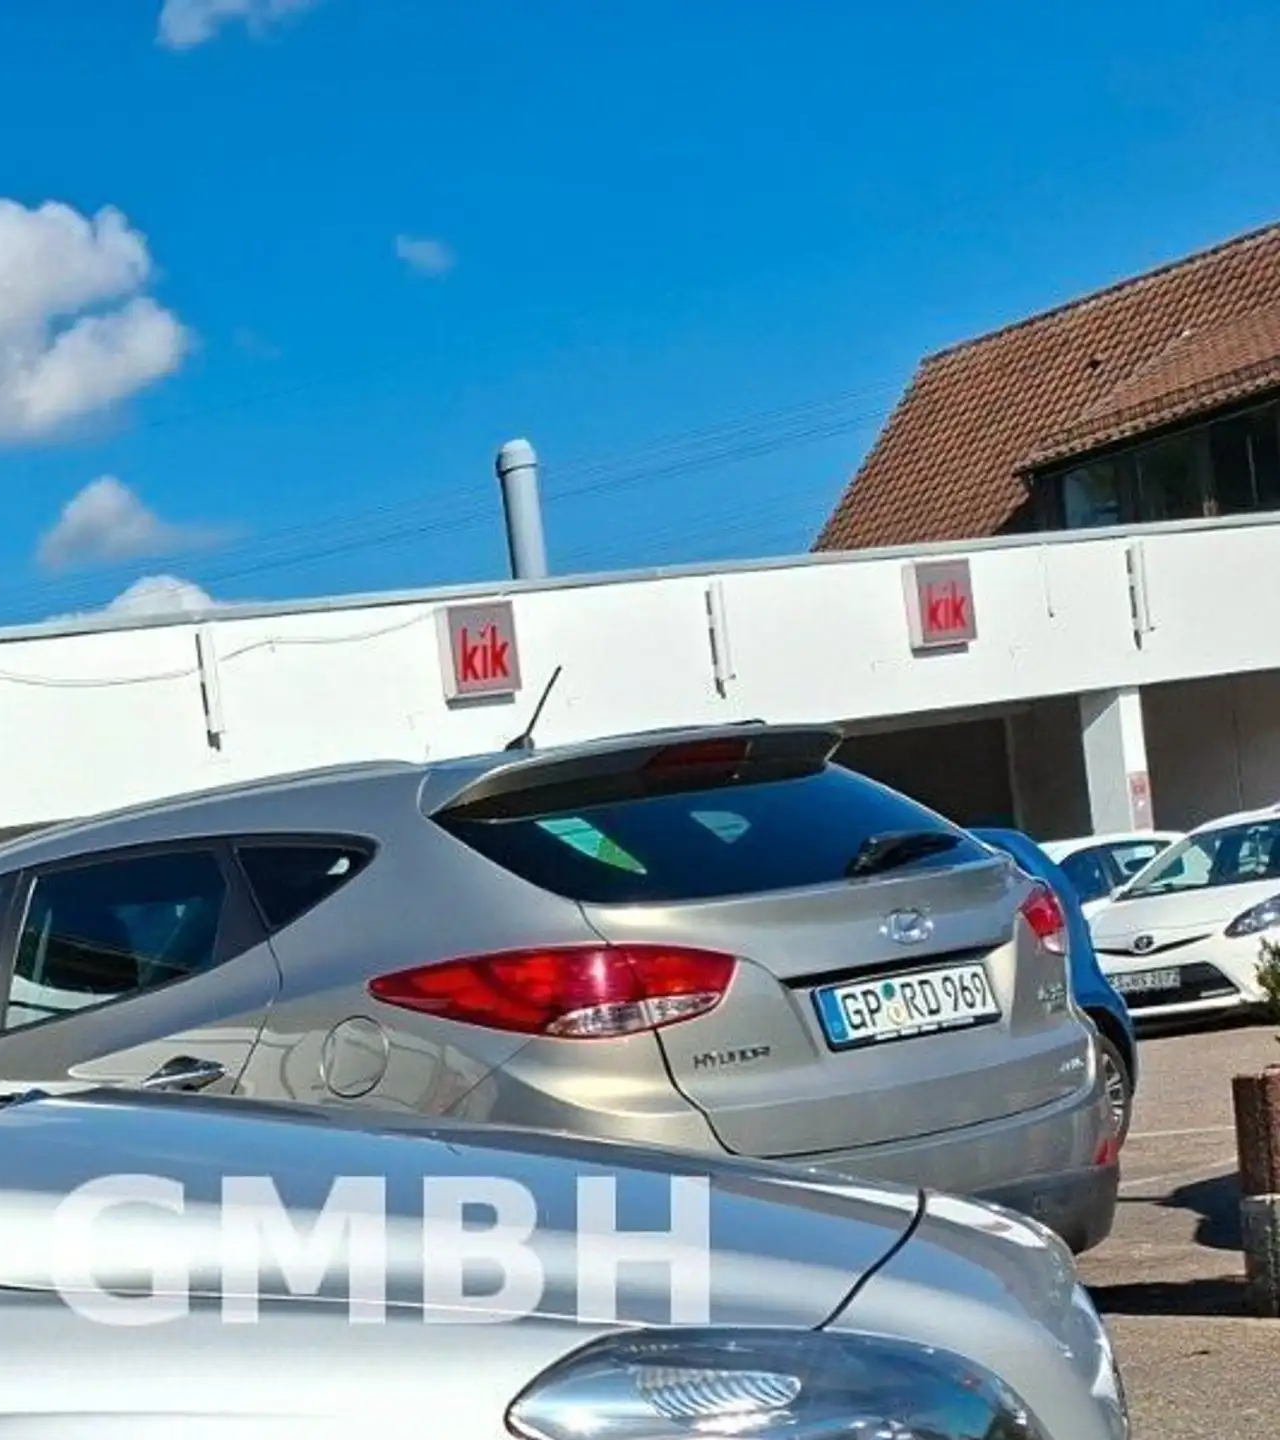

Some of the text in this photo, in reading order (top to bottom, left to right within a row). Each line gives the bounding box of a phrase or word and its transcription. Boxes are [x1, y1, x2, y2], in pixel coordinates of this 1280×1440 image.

[461, 622, 509, 682] kik
[842, 988, 881, 1030] GP
[900, 979, 941, 1020] RD
[942, 971, 987, 1012] 969
